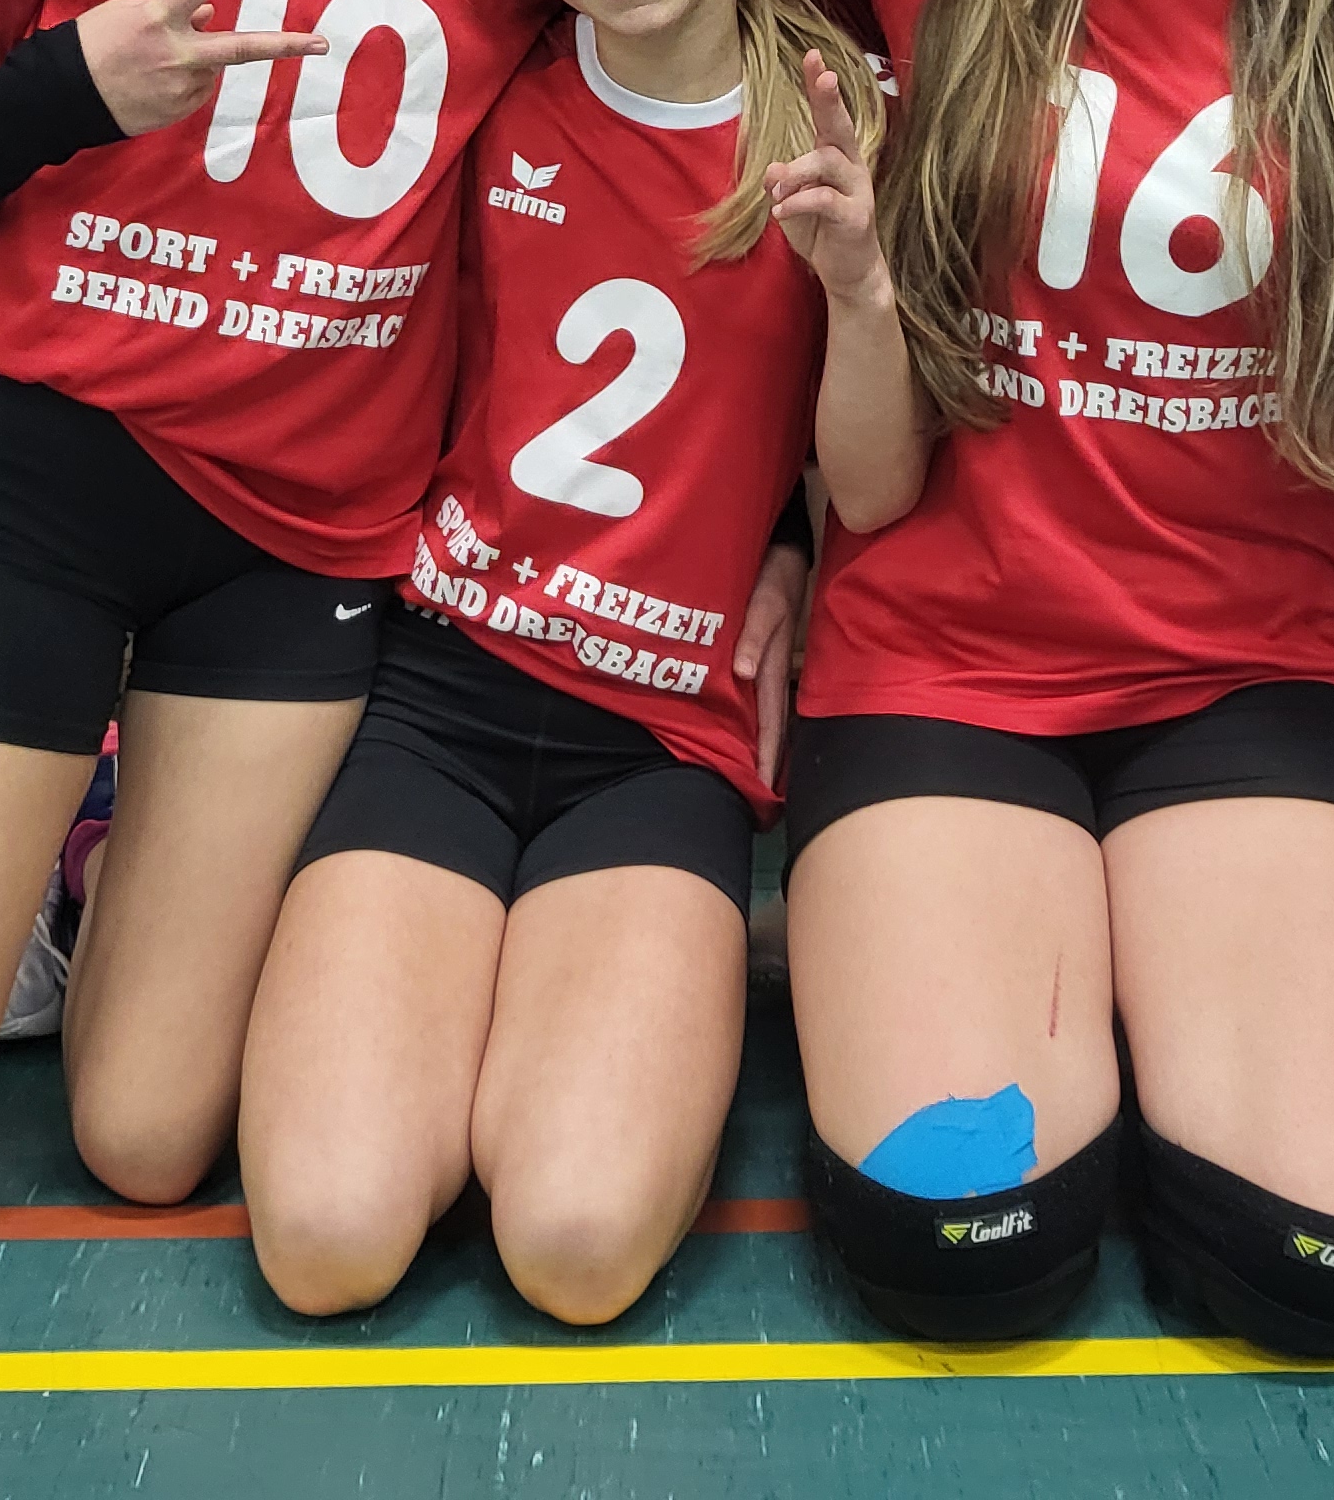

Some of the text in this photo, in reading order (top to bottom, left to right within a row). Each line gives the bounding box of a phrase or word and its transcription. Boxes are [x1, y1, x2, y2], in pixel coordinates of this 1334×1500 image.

[488, 187, 566, 226] erima
[1038, 65, 1274, 317] 16
[66, 211, 430, 303] SPORT + FREIZEI
[51, 265, 405, 349] BERND DREISBAC
[964, 307, 1043, 357] ORT
[1058, 332, 1087, 360] +
[510, 278, 686, 518] 2
[436, 493, 724, 646] SPORT + FREIZEIT
[487, 595, 709, 694] DREISBACH
